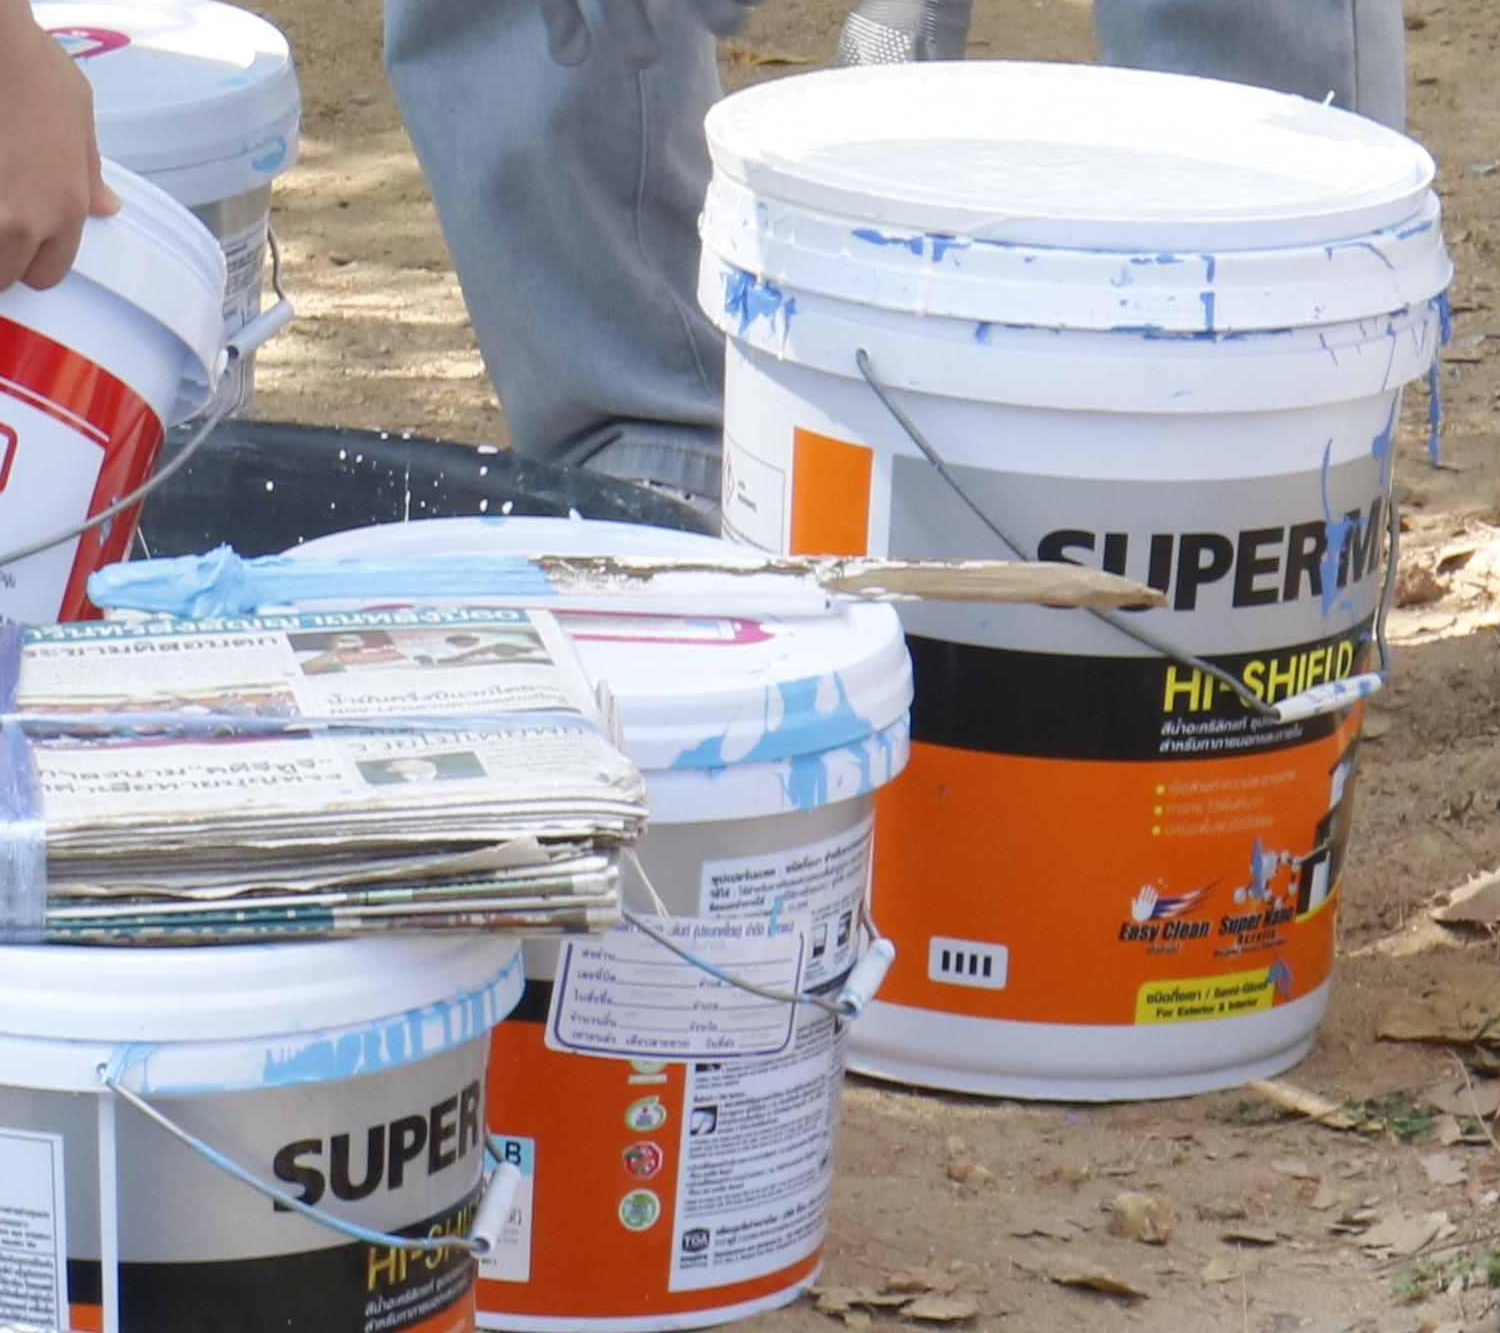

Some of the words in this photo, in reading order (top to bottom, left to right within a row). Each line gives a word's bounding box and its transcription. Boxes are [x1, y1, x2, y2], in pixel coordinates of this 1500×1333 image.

[1118, 921, 1159, 942] Easy
[1162, 920, 1211, 939] Clean
[1219, 912, 1264, 937] Super
[1155, 1004, 1174, 1018] For
[272, 1079, 481, 1213] SUPER
